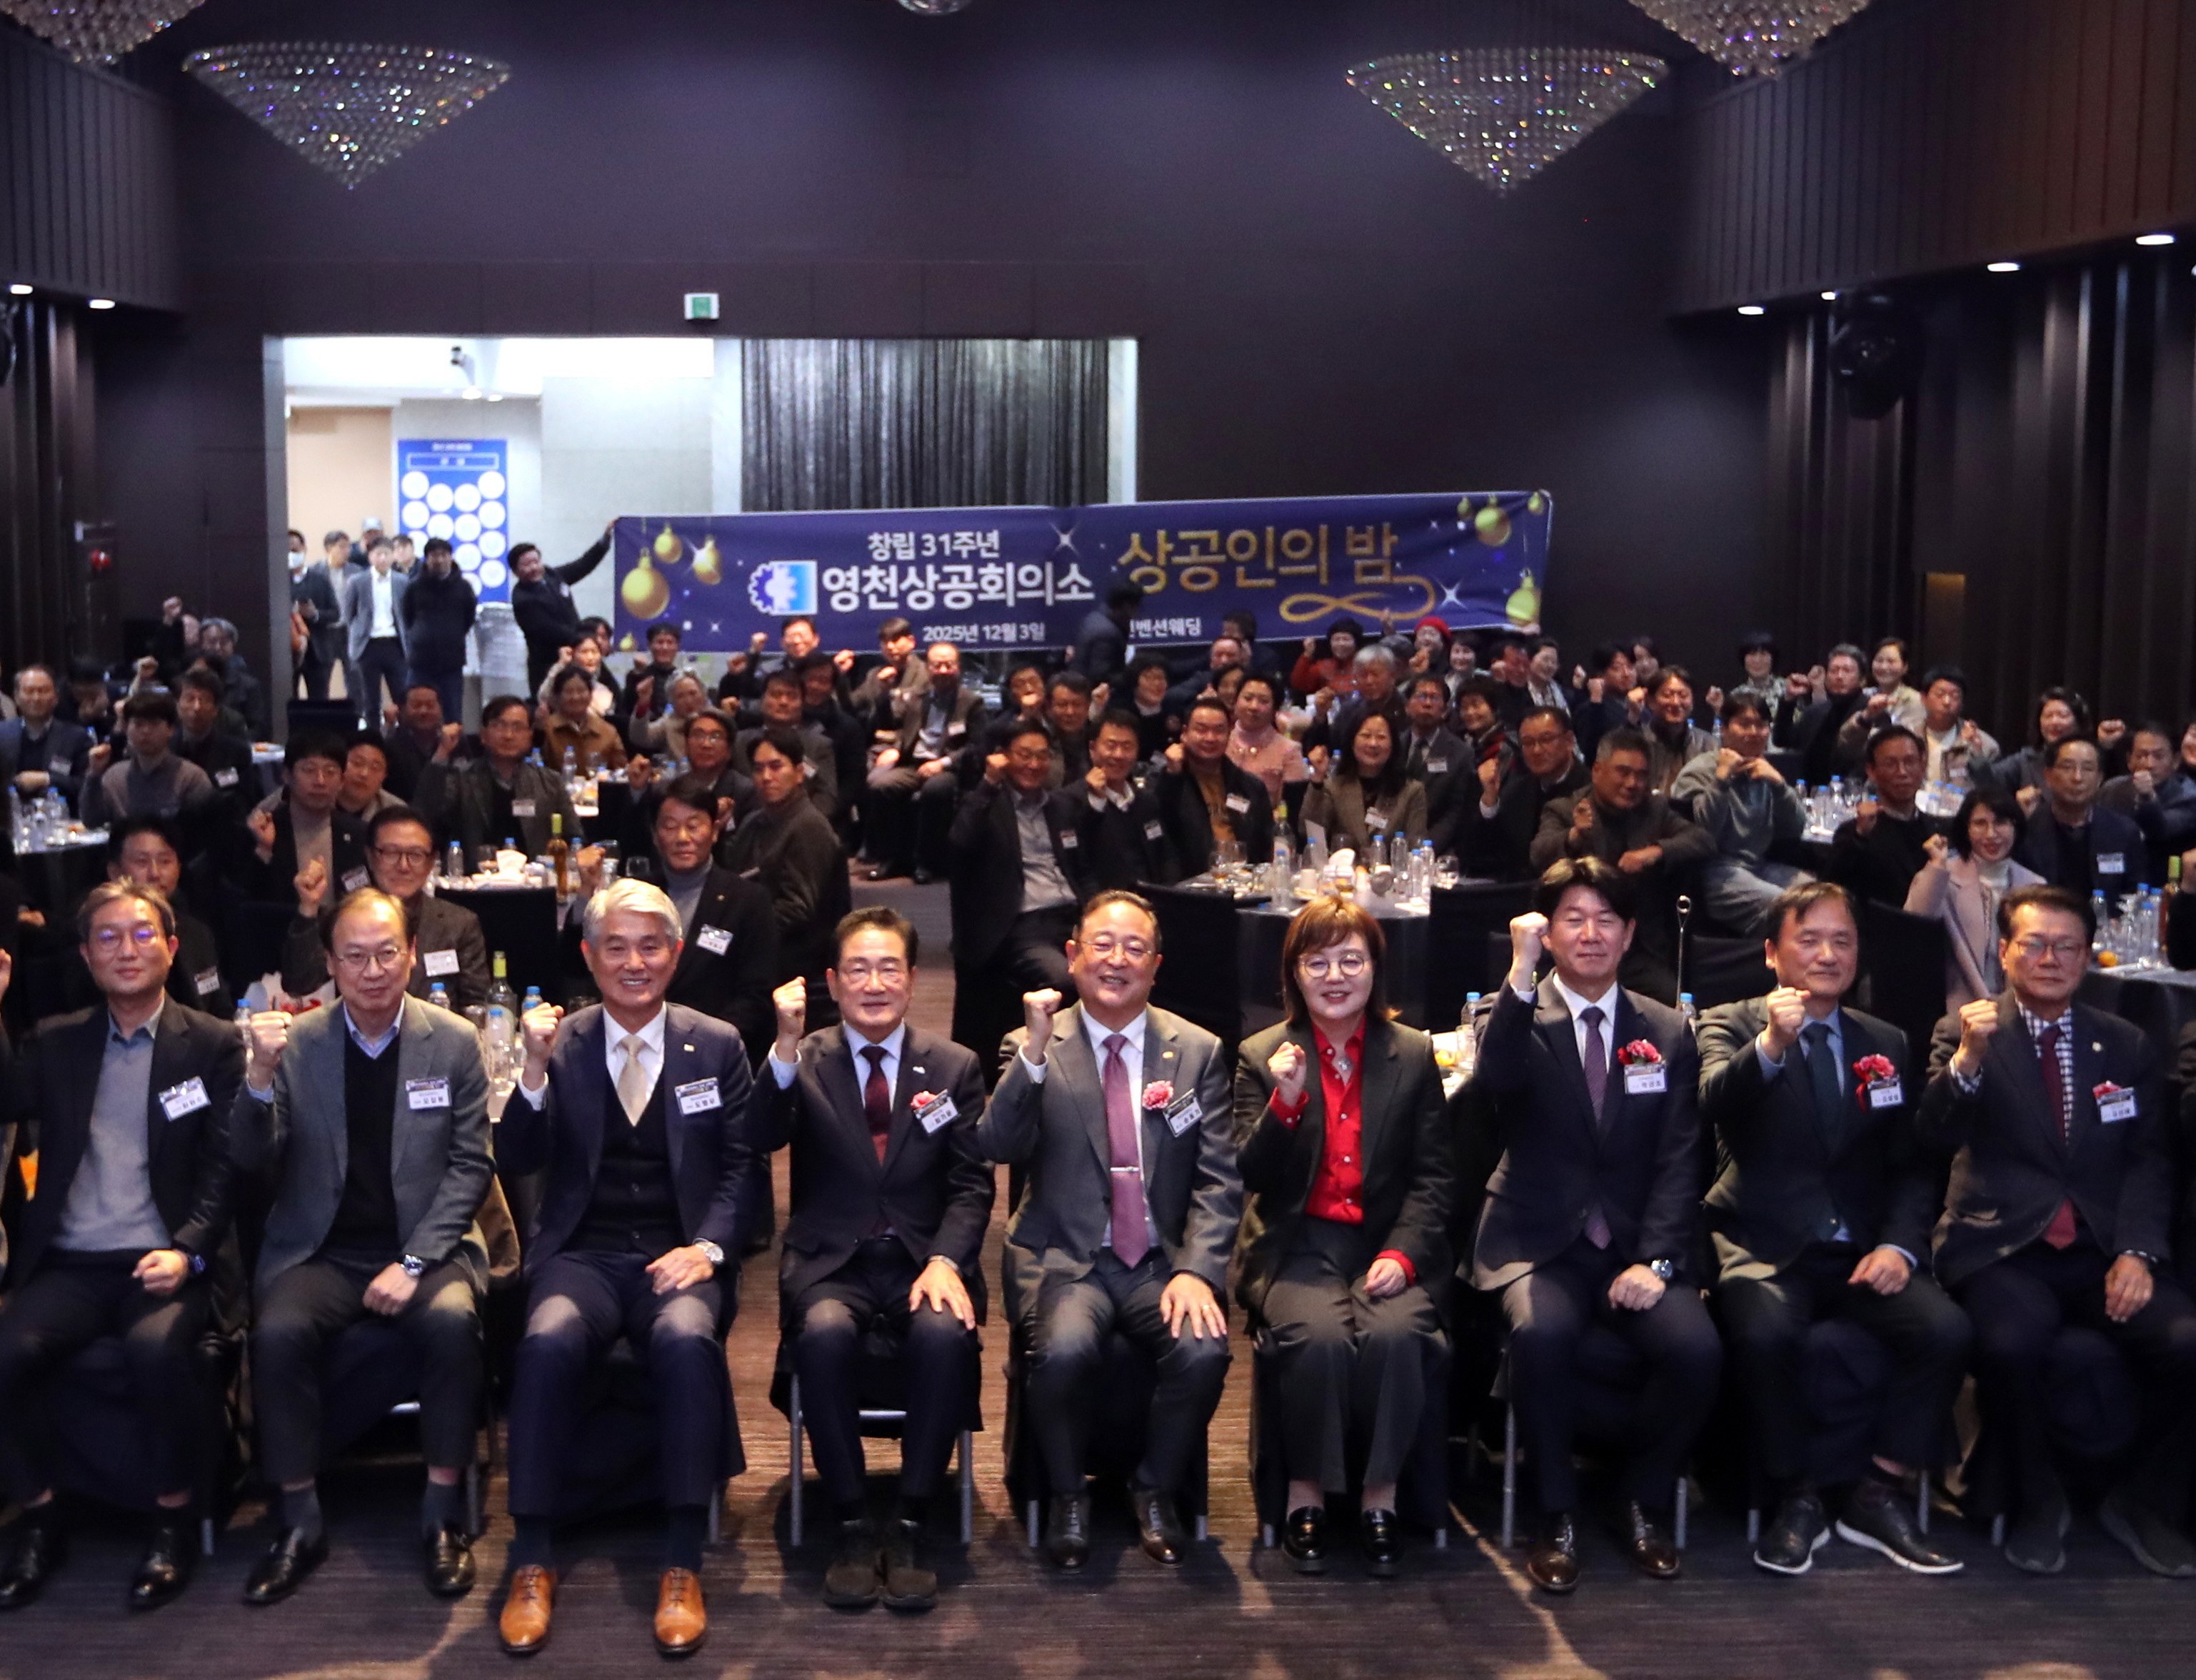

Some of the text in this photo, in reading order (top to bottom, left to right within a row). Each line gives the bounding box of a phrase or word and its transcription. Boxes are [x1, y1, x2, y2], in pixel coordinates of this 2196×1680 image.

[868, 529, 1000, 562] 창립 31주년
[1117, 521, 1398, 594] 상공인의 밤
[822, 560, 1096, 613] 영천상공회의소
[922, 621, 1045, 643] 2025년 12월 3일
